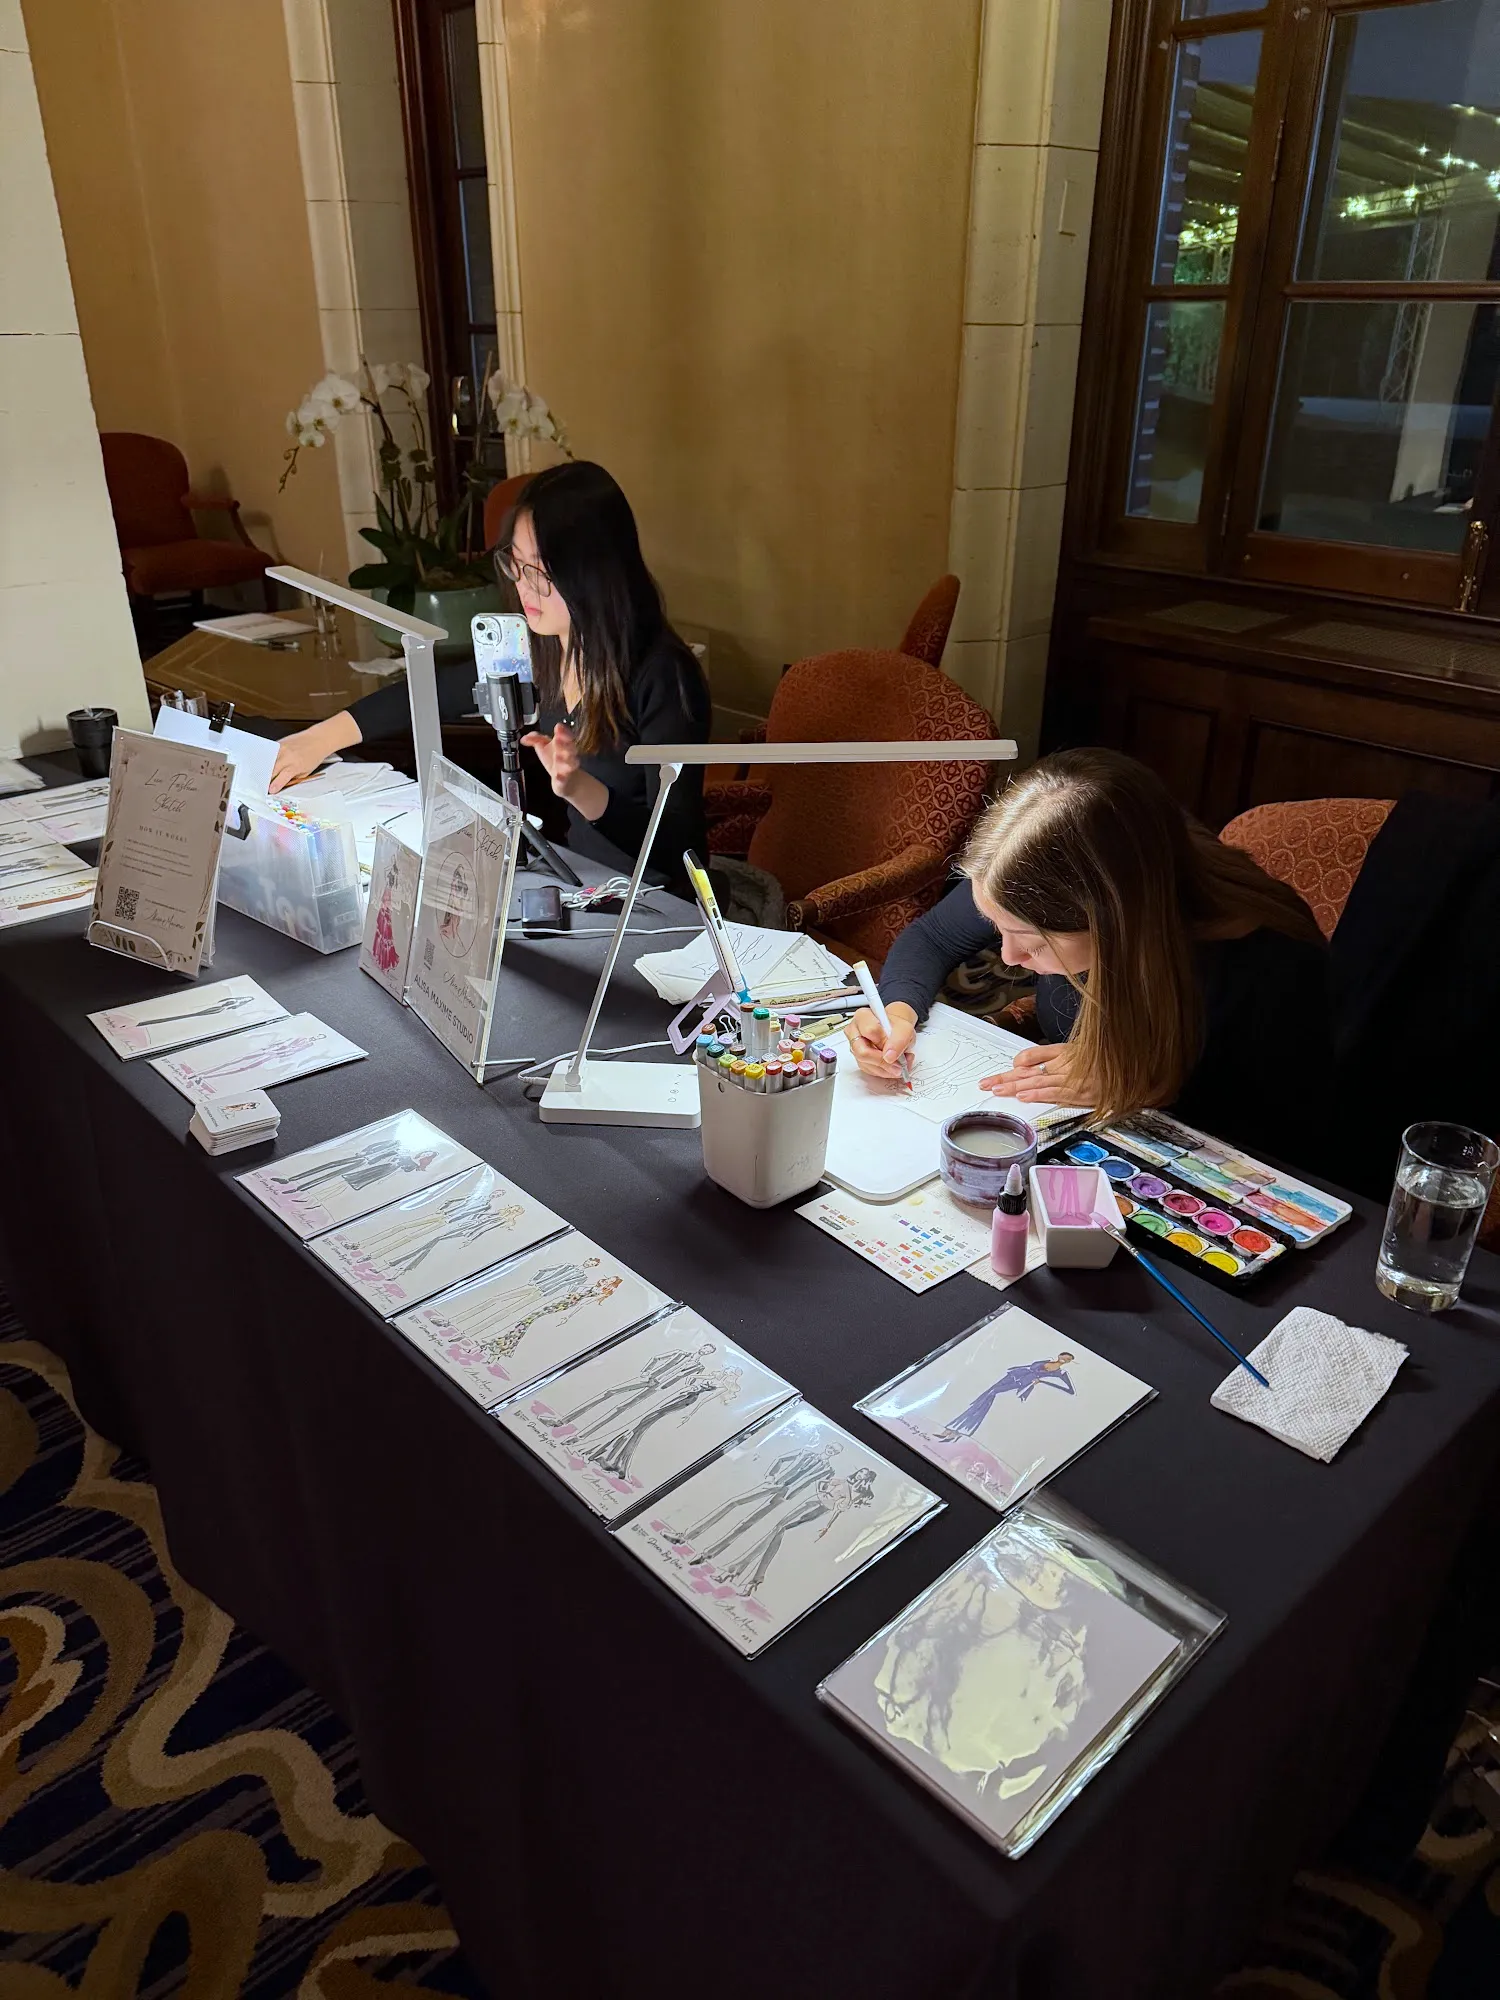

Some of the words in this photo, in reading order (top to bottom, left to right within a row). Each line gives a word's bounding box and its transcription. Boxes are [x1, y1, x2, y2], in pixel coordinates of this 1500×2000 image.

[168, 773, 198, 792] Fashion
[153, 793, 187, 813] Sketch
[139, 825, 152, 834] HOW
[155, 829, 162, 837] IT
[475, 827, 502, 861] Sketch
[414, 974, 430, 998] ALISA
[430, 991, 453, 1022] MAXIME
[452, 1015, 474, 1044] STUDIO
[538, 1431, 549, 1442] Big
[909, 1425, 921, 1435] Big
[647, 1537, 662, 1553] Dream
[661, 1550, 673, 1562] Big
